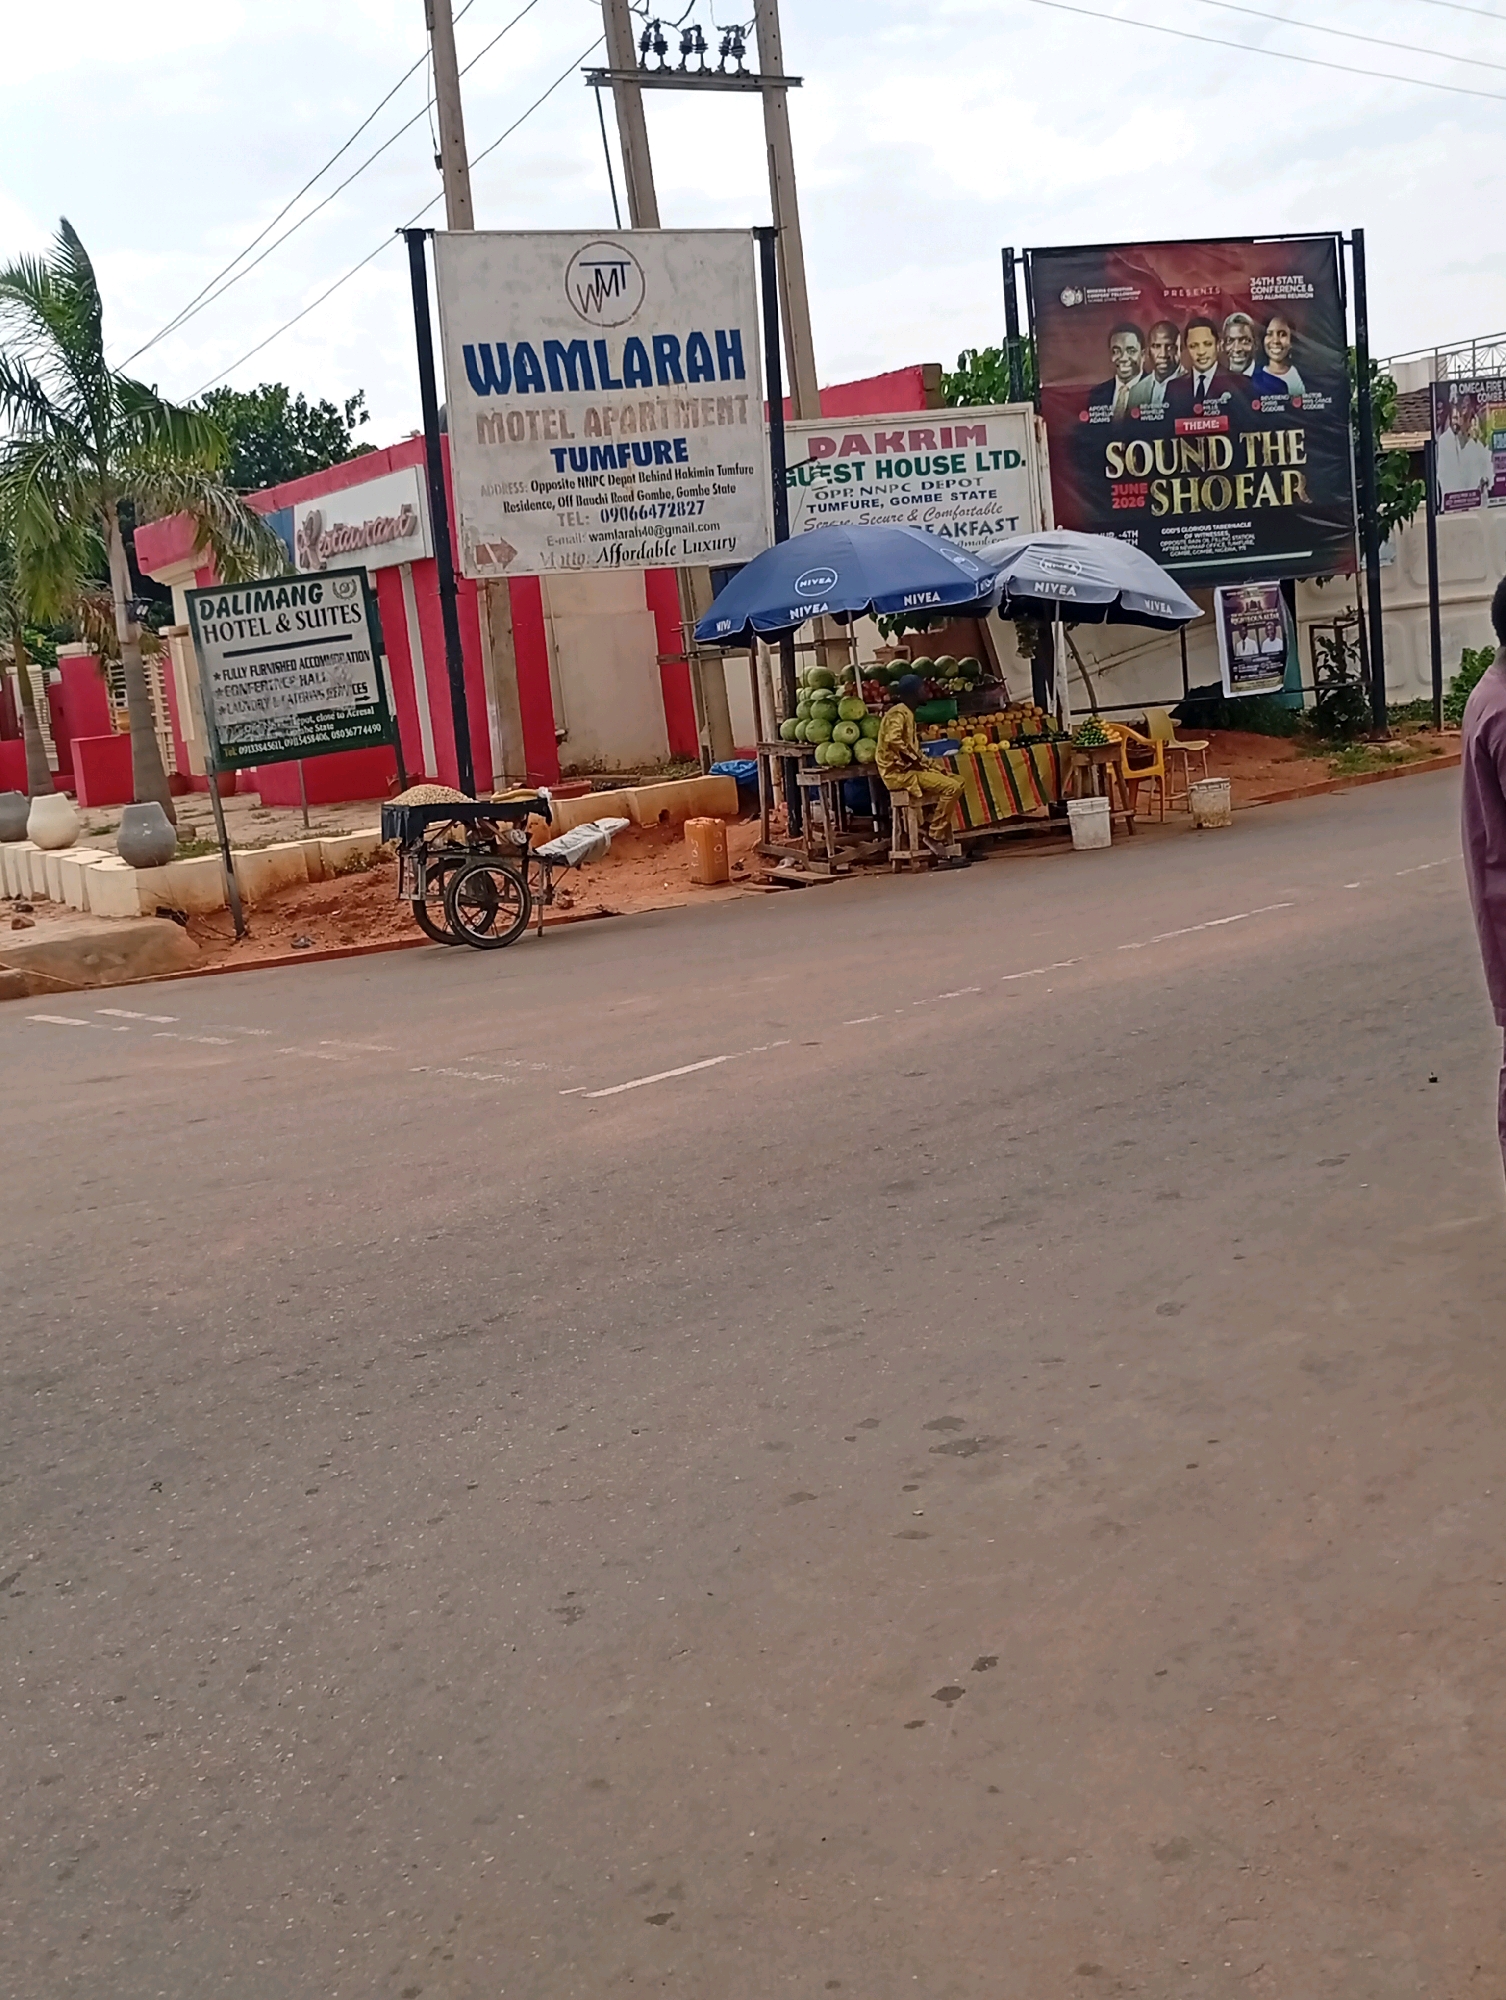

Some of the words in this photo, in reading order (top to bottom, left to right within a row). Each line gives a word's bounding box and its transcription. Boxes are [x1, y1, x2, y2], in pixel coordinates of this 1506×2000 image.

[1163, 286, 1221, 297] PRESENTS
[1251, 284, 1306, 294] CONFERENCE
[1307, 283, 1314, 292] &
[1276, 275, 1304, 285] STATE
[462, 329, 746, 396] WAMLARAH
[1459, 382, 1485, 395] OMEGA
[1486, 380, 1502, 392] FIRE
[476, 406, 575, 445] MOTEL
[583, 394, 749, 439] APARTMENT
[1183, 420, 1220, 431] THEME:
[807, 424, 988, 459] DAKRIM
[550, 438, 689, 473] TUMFURE
[876, 453, 967, 480] HOUSE
[976, 449, 1027, 473] LTD.
[1105, 435, 1233, 479] SOUND
[1239, 429, 1307, 468] THE
[531, 478, 575, 494] Opposite
[577, 474, 605, 489] NNPC
[608, 473, 636, 487] Depot
[639, 468, 672, 483] Behind
[675, 466, 714, 480] Hakimin
[717, 462, 754, 477] Tumfure
[815, 488, 854, 500] OPP.
[860, 482, 911, 497] NNPC
[921, 477, 984, 491] DEPOT
[1111, 482, 1148, 496] JUNE
[503, 499, 555, 513] Residence,
[558, 495, 574, 508] Off
[576, 493, 608, 507] Bauchi
[611, 490, 634, 504] Road
[637, 488, 674, 502] Gombe,
[677, 484, 710, 498] Gombe
[712, 483, 736, 495] State
[807, 498, 884, 514] TUMFURE,
[890, 493, 943, 507] GOMBE
[950, 490, 998, 502] STATE
[1112, 497, 1145, 509] 2026
[1150, 470, 1313, 517] SHOFAR
[556, 511, 590, 527] TEL:
[600, 500, 705, 524] 09066472827
[859, 511, 904, 526] Secure
[907, 508, 919, 522] &
[922, 502, 1004, 524] Comfortable
[297, 504, 418, 571] Restaurant
[589, 522, 720, 542] wamlarah40@gmail.com
[596, 538, 677, 565] Affordable
[682, 537, 737, 555] Luxury
[800, 577, 832, 588] NIVEA
[1034, 582, 1077, 597] NIVEA
[200, 583, 323, 621] DALIMANG
[904, 591, 941, 606] NIVEA
[1144, 600, 1173, 614] NIVEA
[790, 603, 829, 620] NIVEA
[202, 617, 272, 644] HOTEL
[275, 613, 291, 634] &
[295, 603, 362, 631] SUITES
[223, 666, 248, 681] FULLY
[250, 659, 297, 677] FURNISHED
[337, 711, 345, 720] to
[315, 723, 335, 732] State
